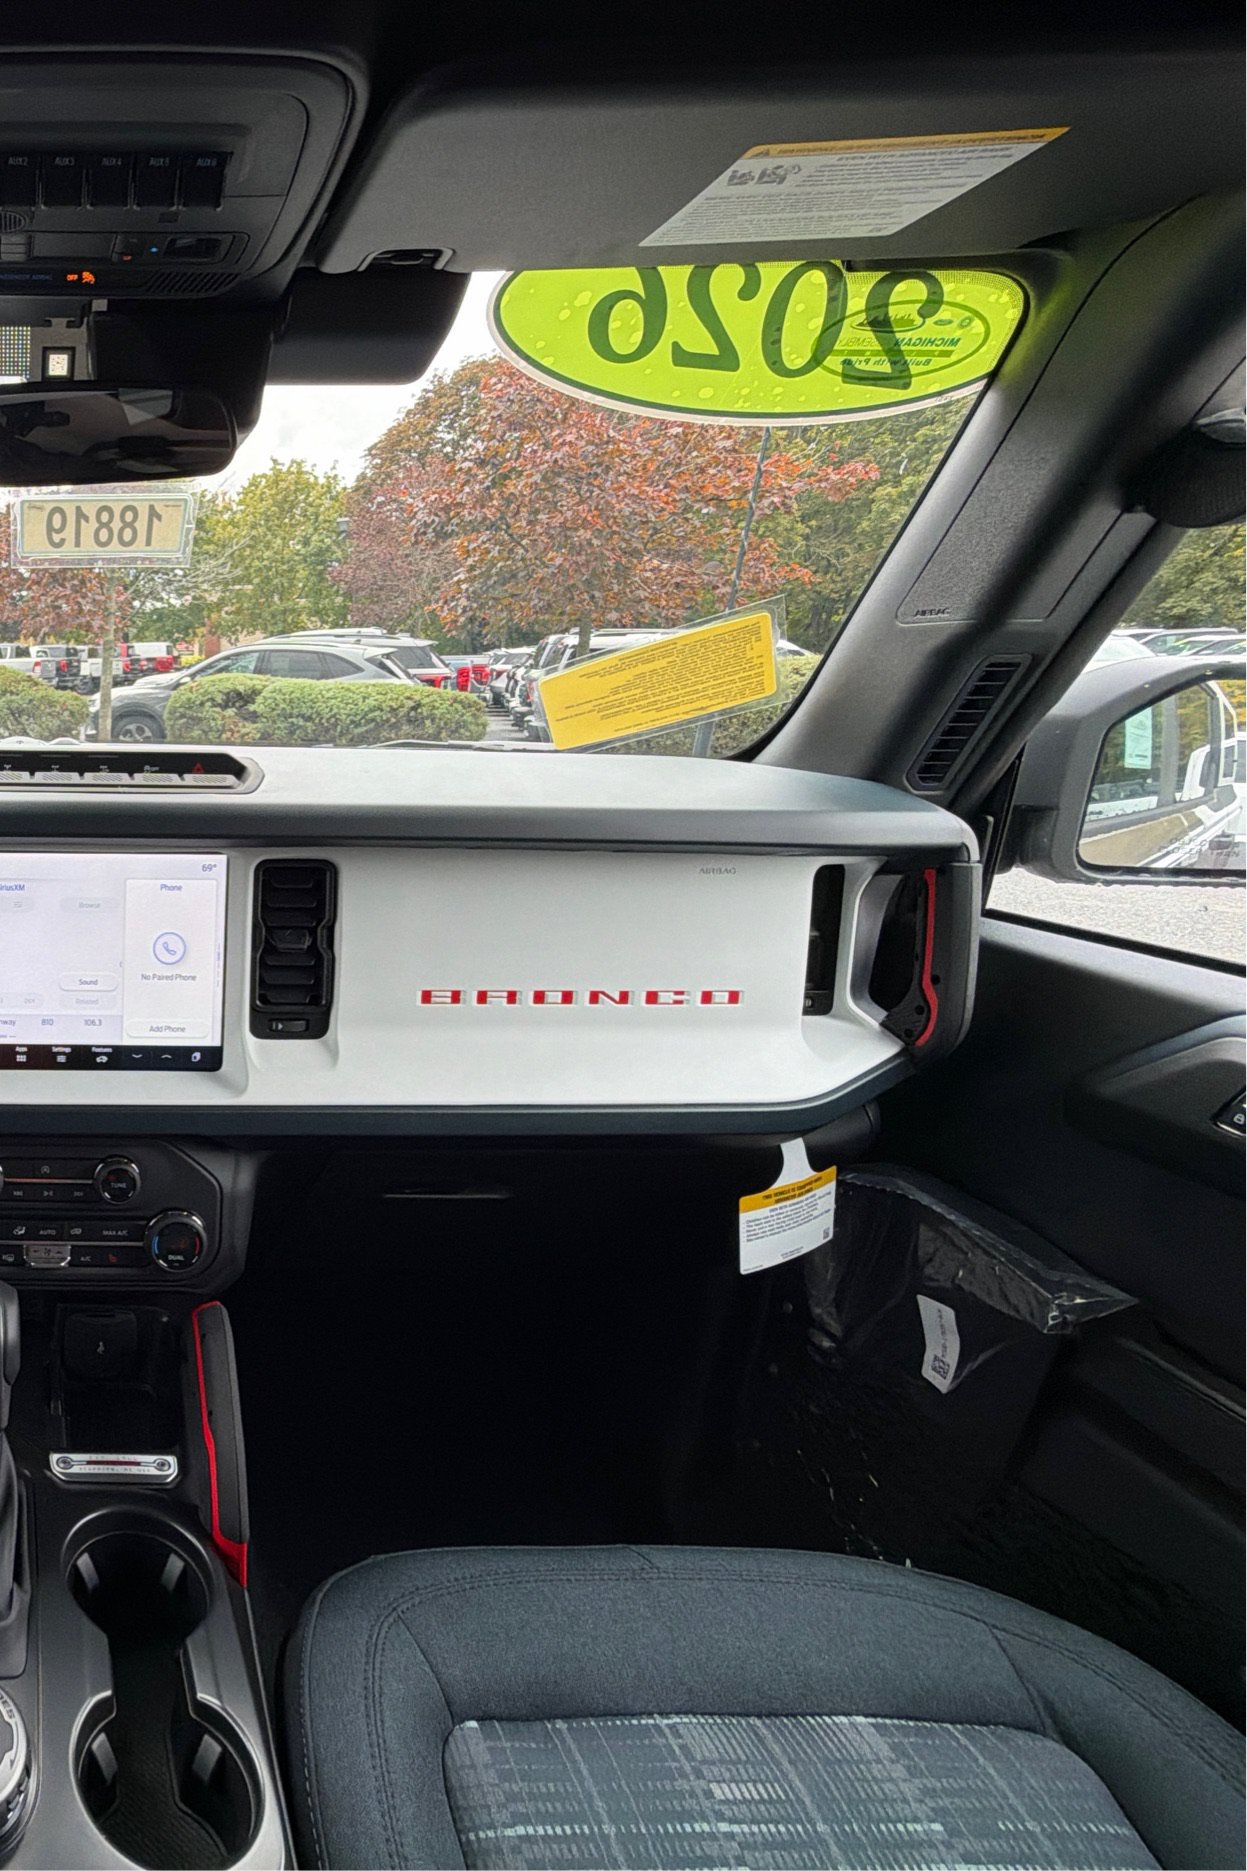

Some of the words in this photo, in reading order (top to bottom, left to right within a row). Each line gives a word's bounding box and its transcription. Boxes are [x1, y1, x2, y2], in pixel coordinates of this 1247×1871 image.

[160, 883, 182, 892] Phone
[141, 973, 152, 981] No
[154, 973, 174, 981] Paired
[175, 973, 197, 981] Phone
[419, 989, 742, 1006] BRONCO
[149, 1025, 162, 1033] Add
[164, 1025, 186, 1033] Phone
